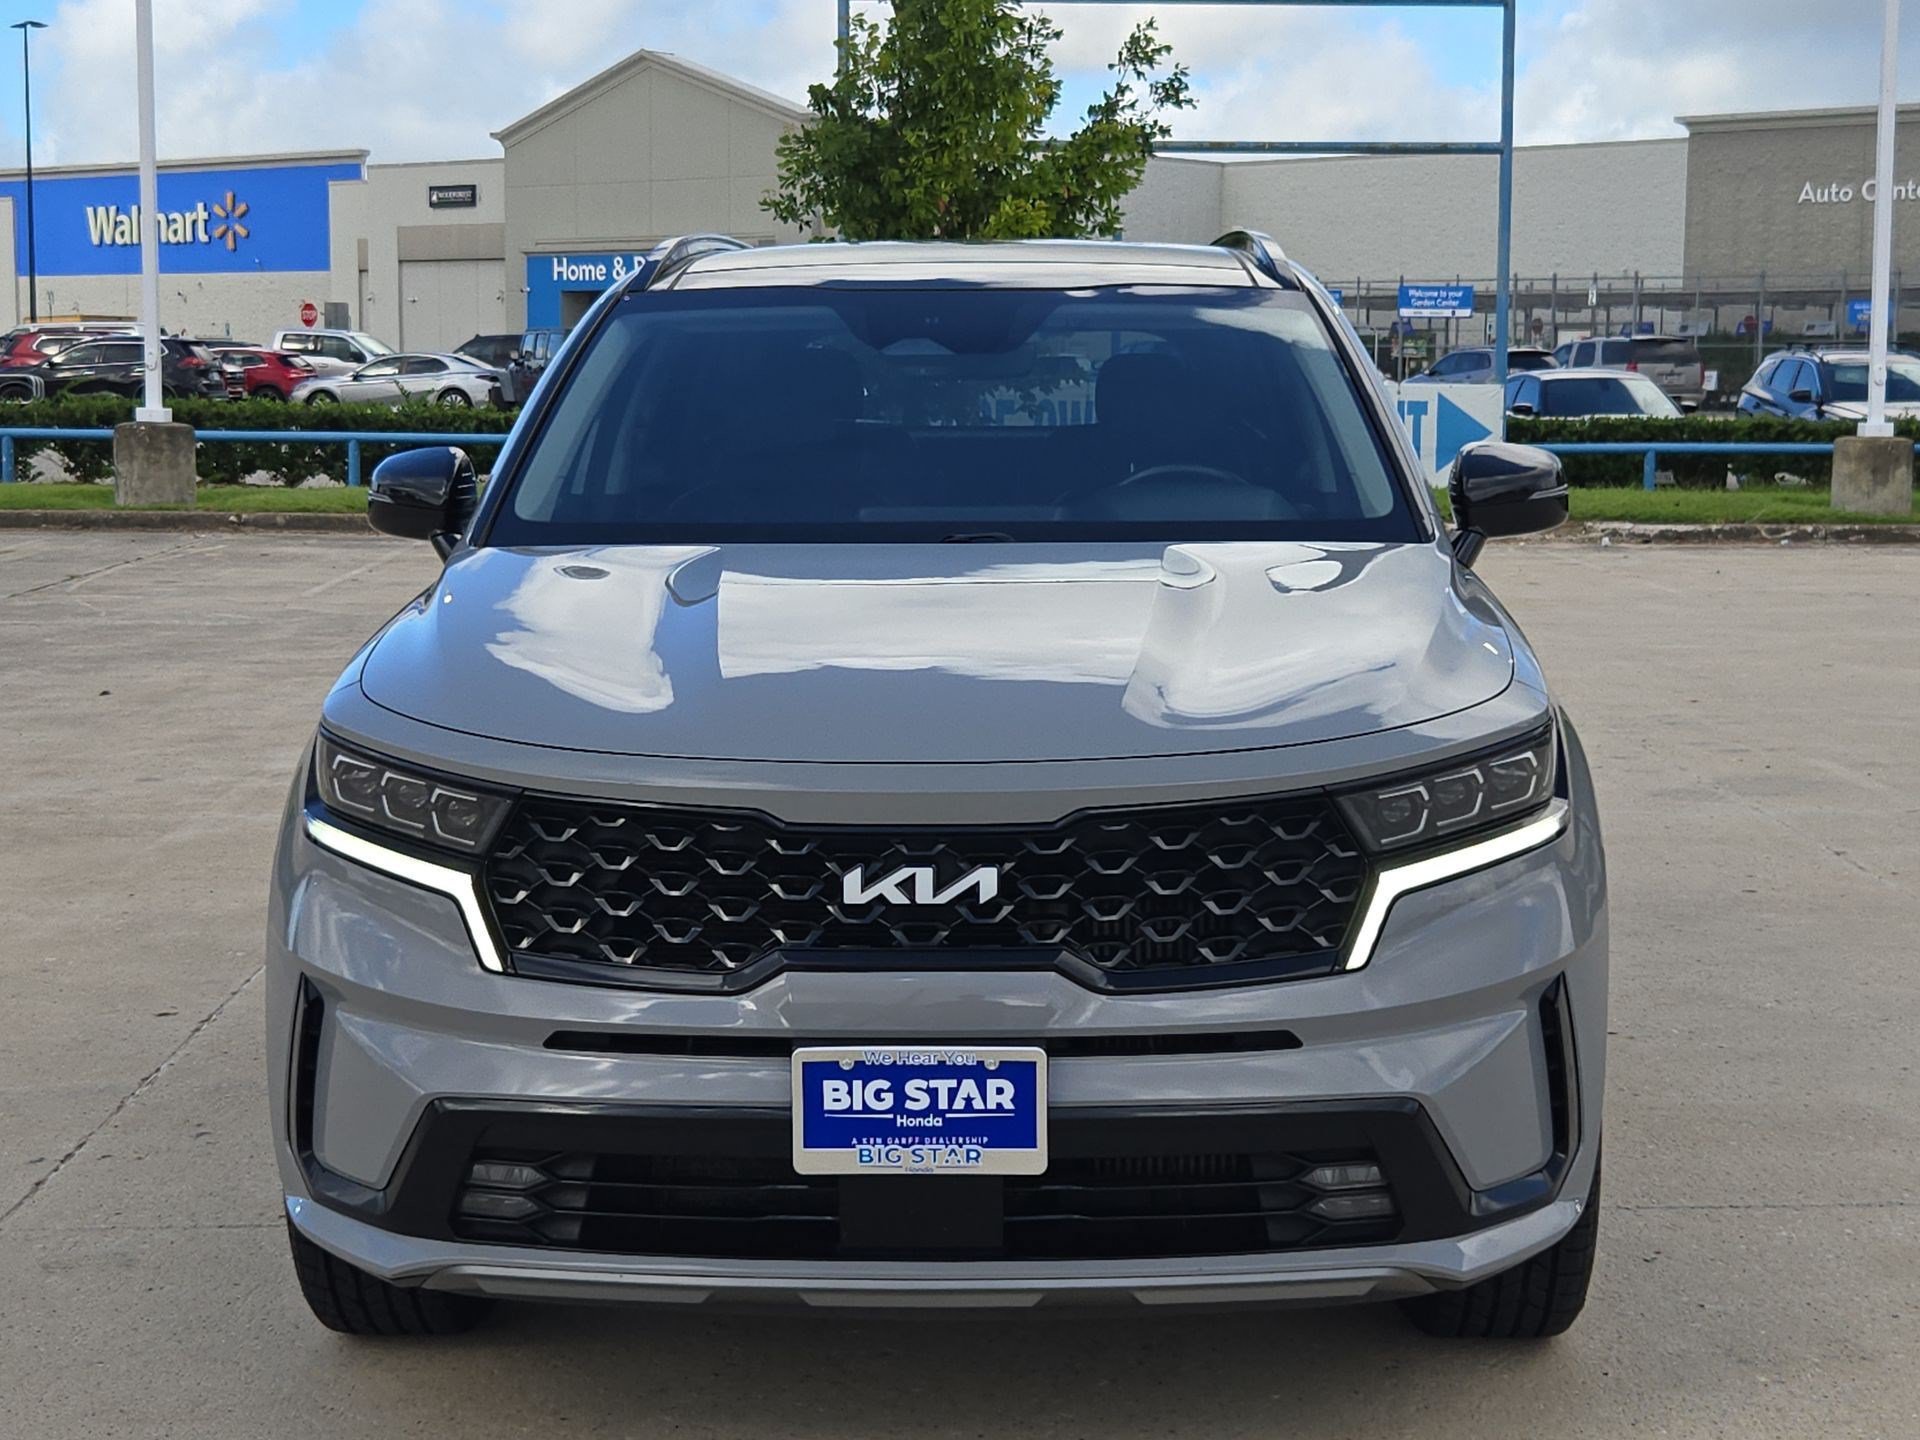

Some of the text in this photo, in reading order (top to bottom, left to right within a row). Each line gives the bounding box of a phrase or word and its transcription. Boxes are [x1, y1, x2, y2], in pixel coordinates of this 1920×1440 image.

[1798, 181, 1853, 203] Auto
[553, 257, 606, 281] Home
[612, 256, 626, 280] &
[1408, 289, 1464, 300] Welcome to your
[1436, 298, 1460, 307] Center
[302, 310, 316, 320] STOP
[843, 866, 998, 904] KIA
[864, 1050, 976, 1065] We Hear You
[822, 1078, 1016, 1111] BIG STAR
[896, 1114, 943, 1127] Honda
[925, 1136, 989, 1145] DEALERSHIP
[858, 1147, 982, 1164] BIG STAR
